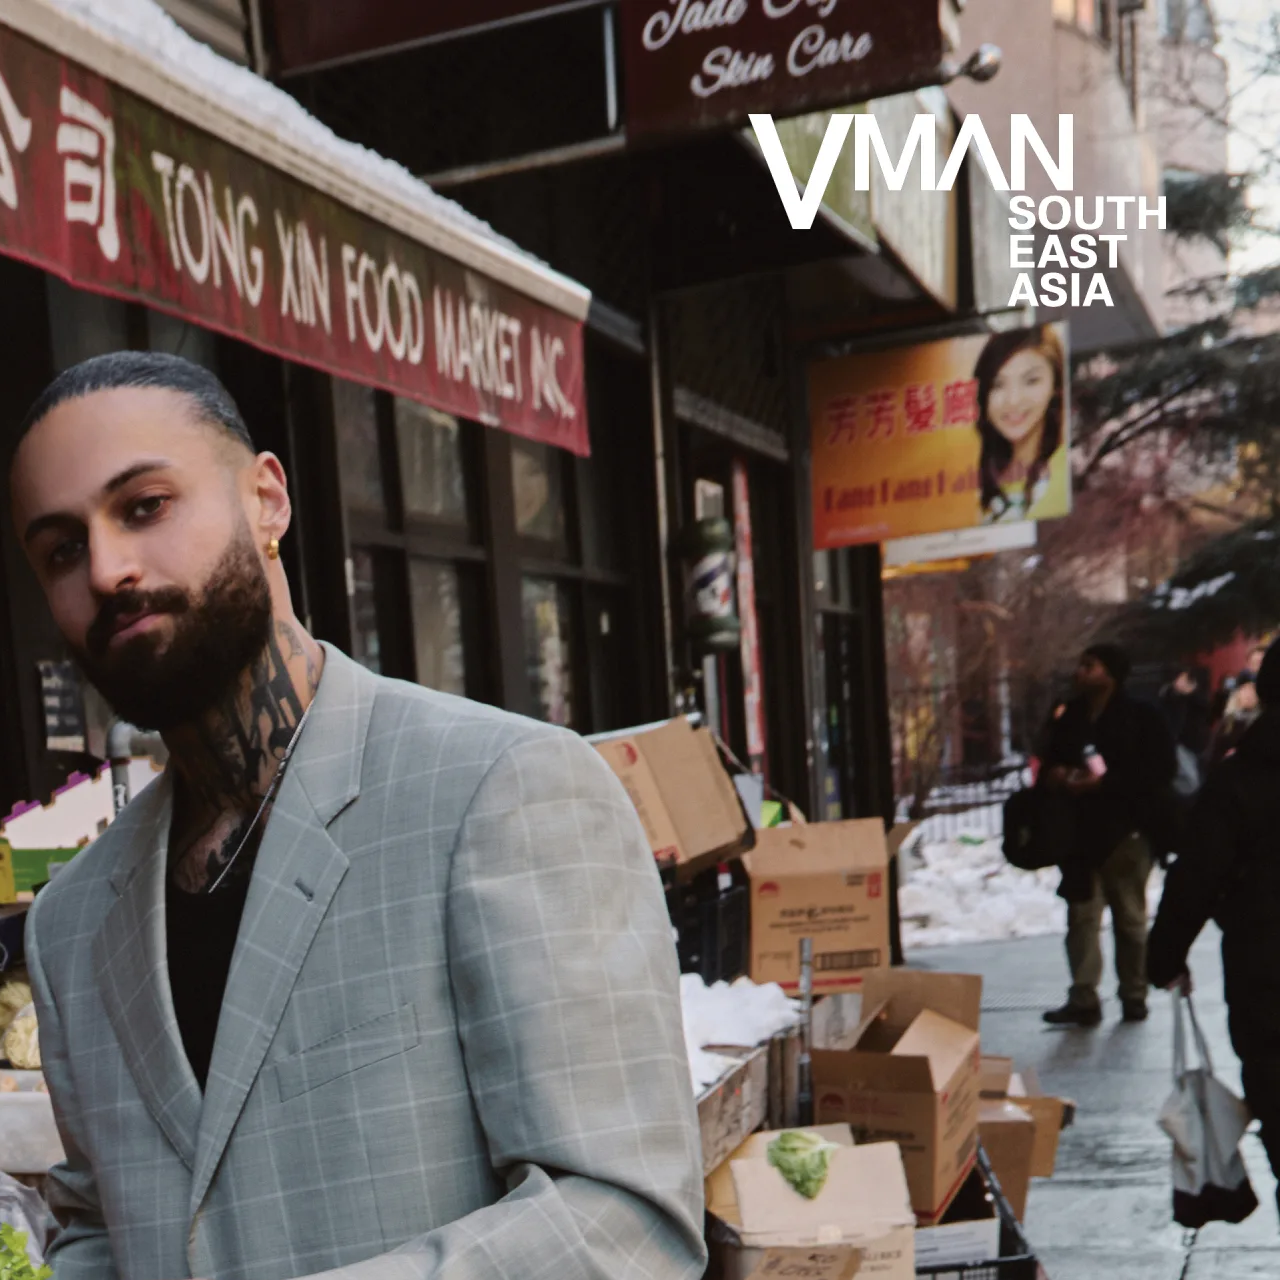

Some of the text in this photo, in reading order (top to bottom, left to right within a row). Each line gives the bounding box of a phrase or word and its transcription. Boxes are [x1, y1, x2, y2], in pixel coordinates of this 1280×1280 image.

[690, 25, 872, 98] Skin Care
[151, 151, 264, 306] TONG
[274, 209, 331, 334] XIN
[342, 244, 422, 365] FOOD
[433, 285, 522, 403] MARKET
